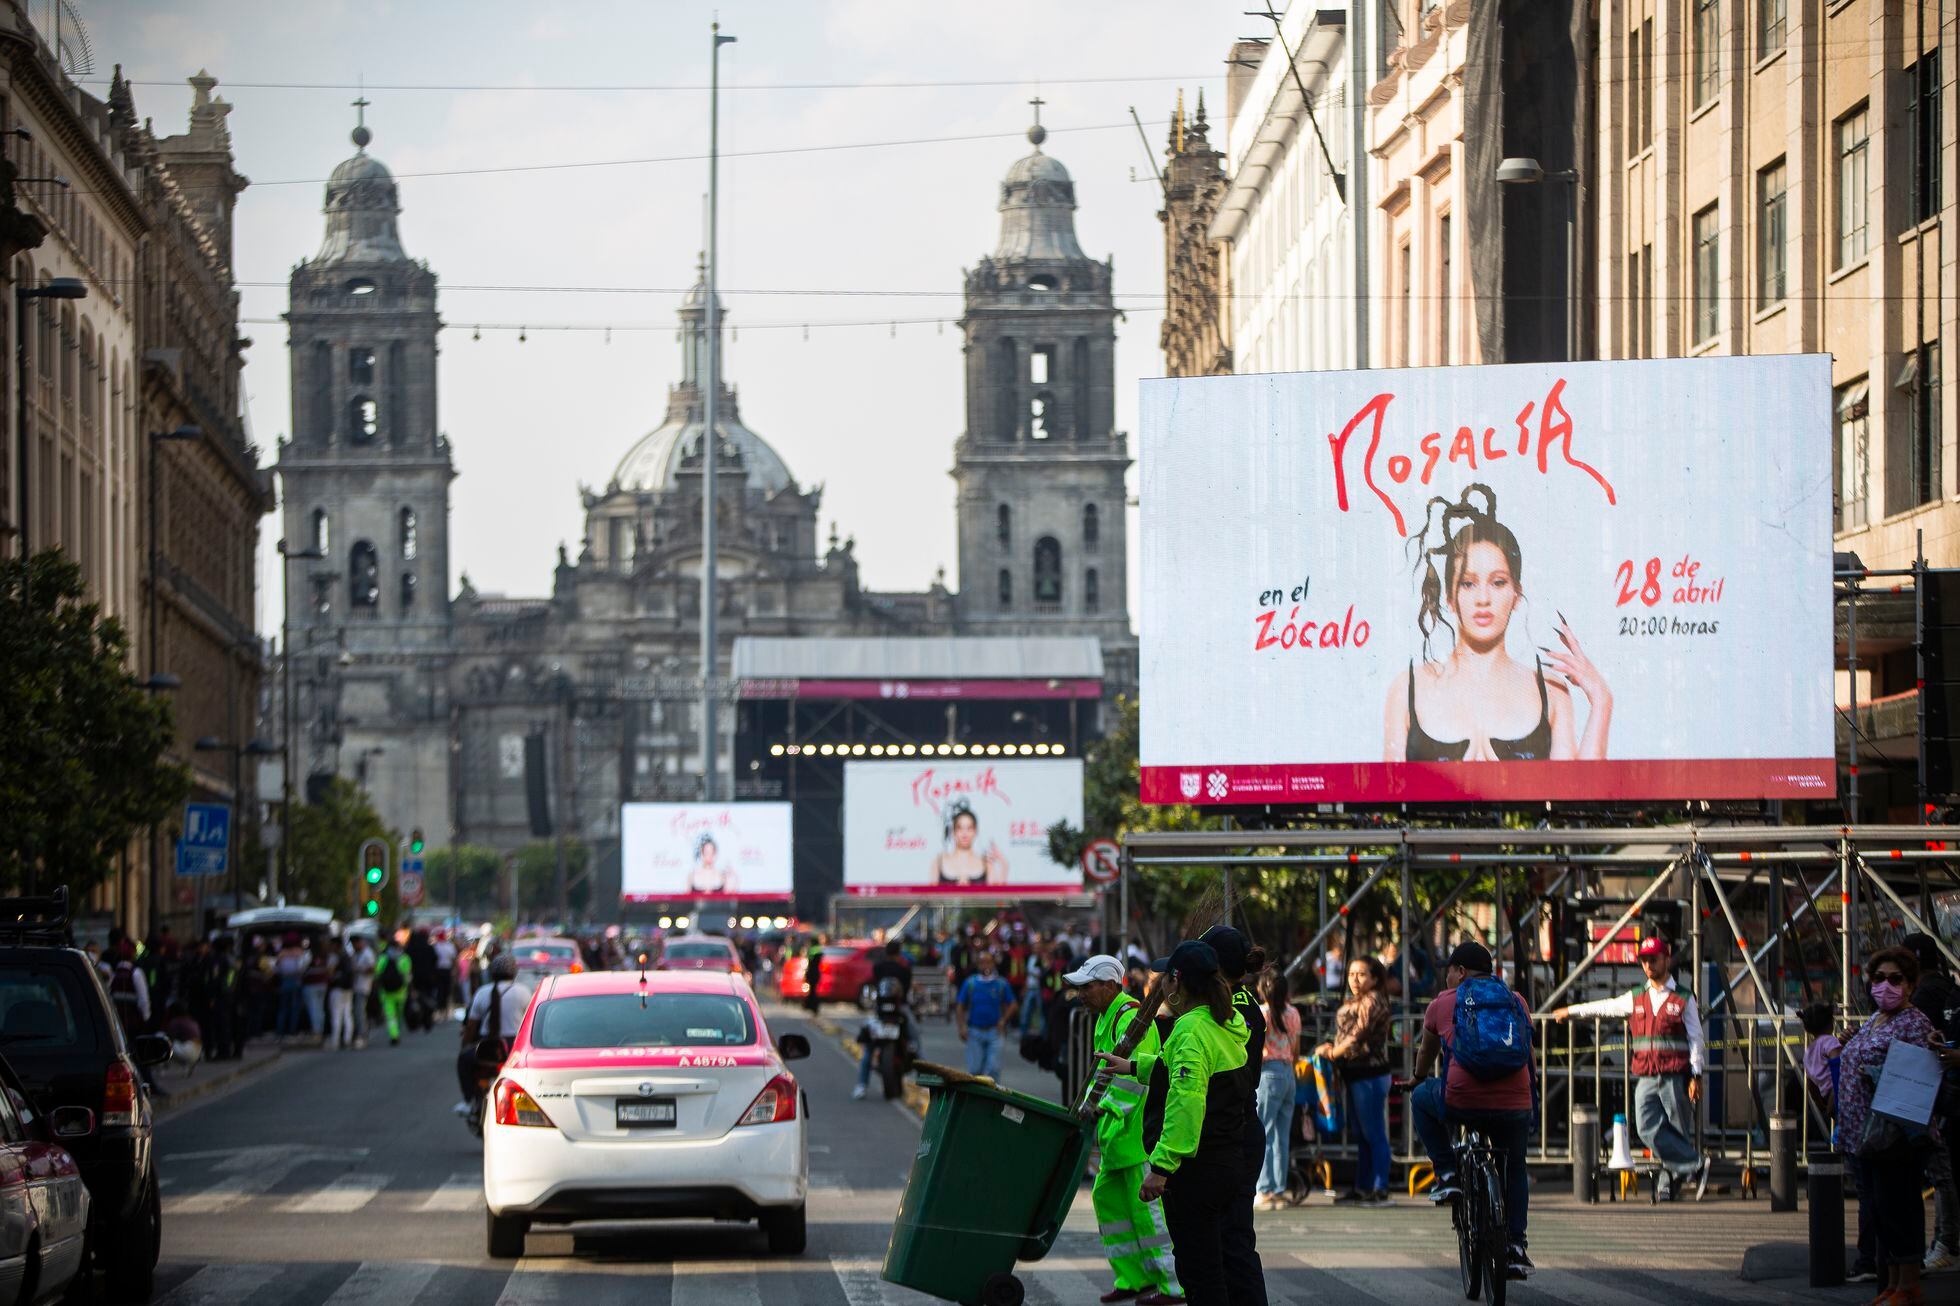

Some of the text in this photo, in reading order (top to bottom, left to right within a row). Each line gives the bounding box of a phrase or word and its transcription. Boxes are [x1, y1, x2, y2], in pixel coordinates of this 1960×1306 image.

[1671, 553, 1701, 578] de
[1259, 575, 1310, 607] en el
[1613, 556, 1662, 608] 28
[1672, 576, 1725, 605] abril
[1254, 603, 1371, 651] Zócalo
[1619, 615, 1720, 636] 20:00 horas
